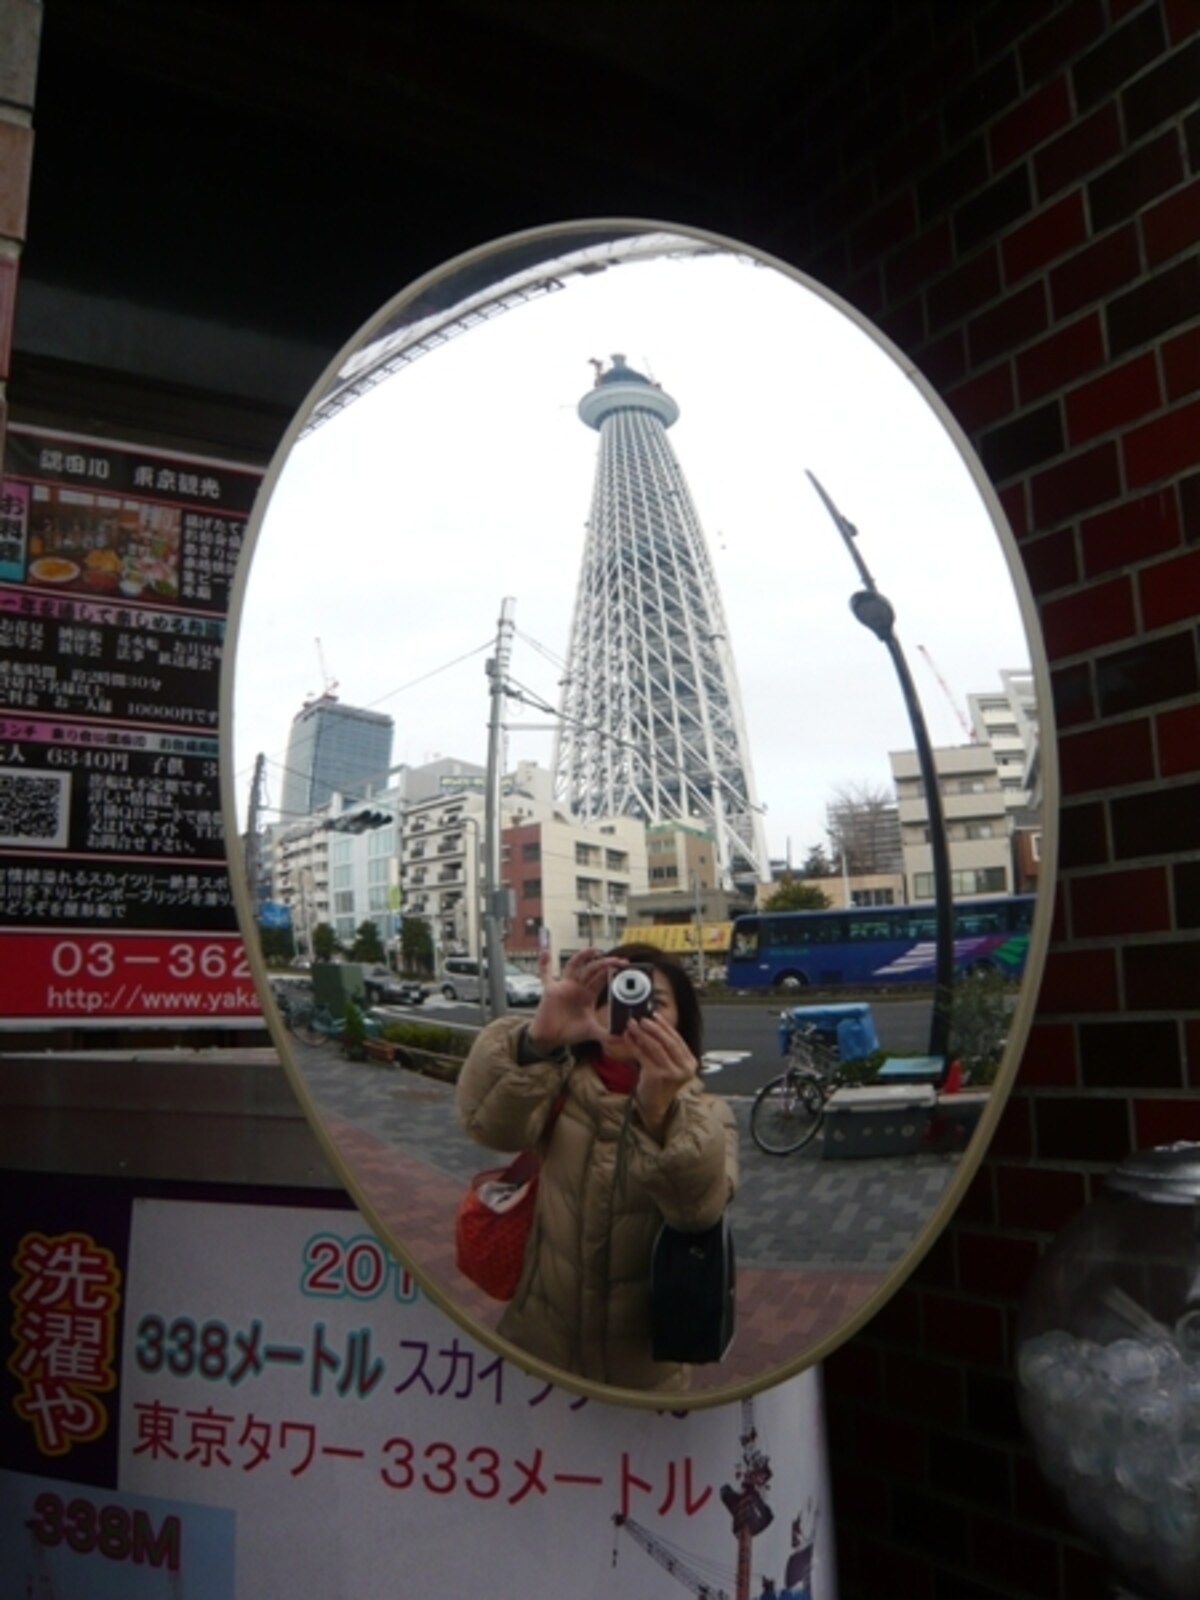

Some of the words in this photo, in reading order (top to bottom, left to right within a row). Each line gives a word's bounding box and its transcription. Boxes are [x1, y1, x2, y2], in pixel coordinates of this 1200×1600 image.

[133, 465, 221, 499] 東京観光
[47, 747, 130, 772] 6340円
[152, 757, 186, 777] 子供
[15, 1236, 114, 1453] 洗濯や
[134, 1313, 385, 1401] 338メートル
[131, 1400, 365, 1477] 東京タワー
[380, 1436, 713, 1518] 333メートル
[33, 1492, 181, 1572] 338M
